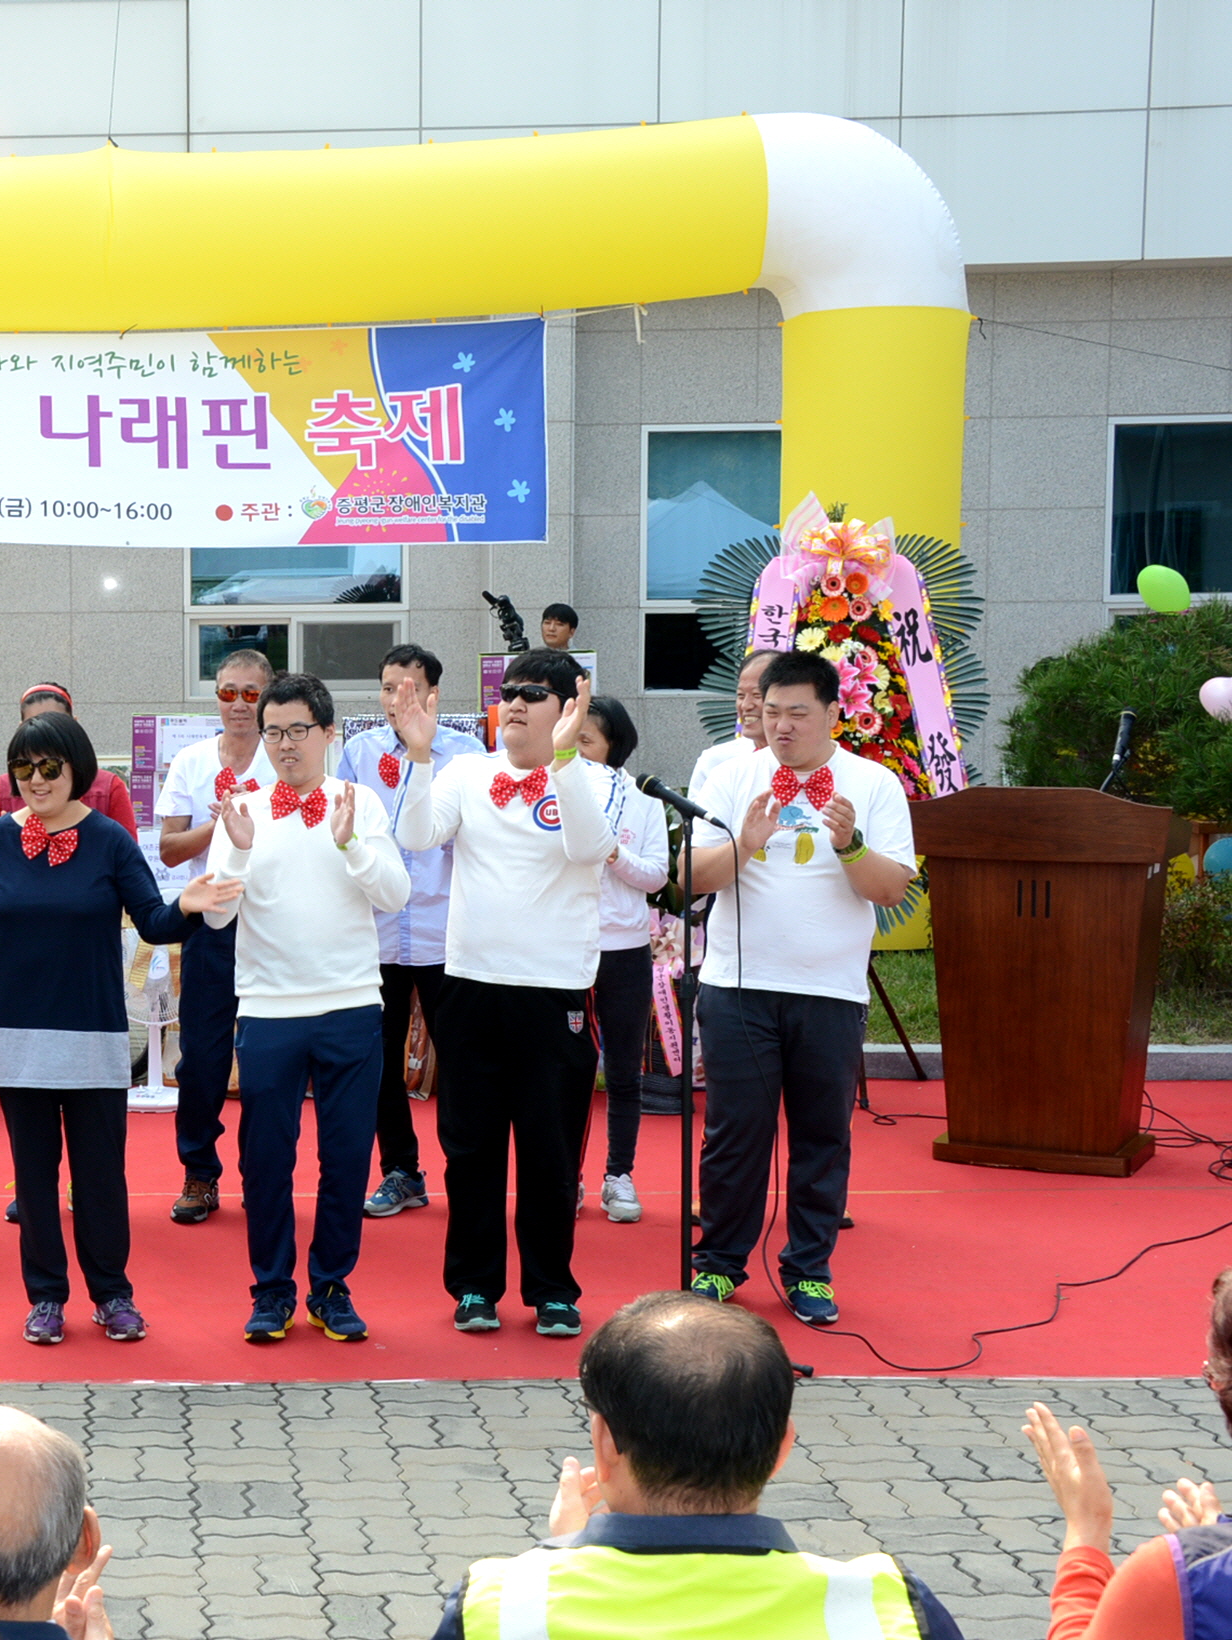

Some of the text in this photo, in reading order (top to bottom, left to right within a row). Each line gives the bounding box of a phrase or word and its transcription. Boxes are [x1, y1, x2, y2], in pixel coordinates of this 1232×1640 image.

[51, 351, 175, 379] 지역주민이
[189, 348, 303, 378] 함께하는
[39, 395, 272, 470] 나래핀
[307, 385, 463, 468] 축제
[40, 501, 173, 520] 10:00~16:00
[240, 503, 281, 522] 주관
[336, 495, 486, 515] 증평군장애인복지관
[757, 604, 790, 648] 한국
